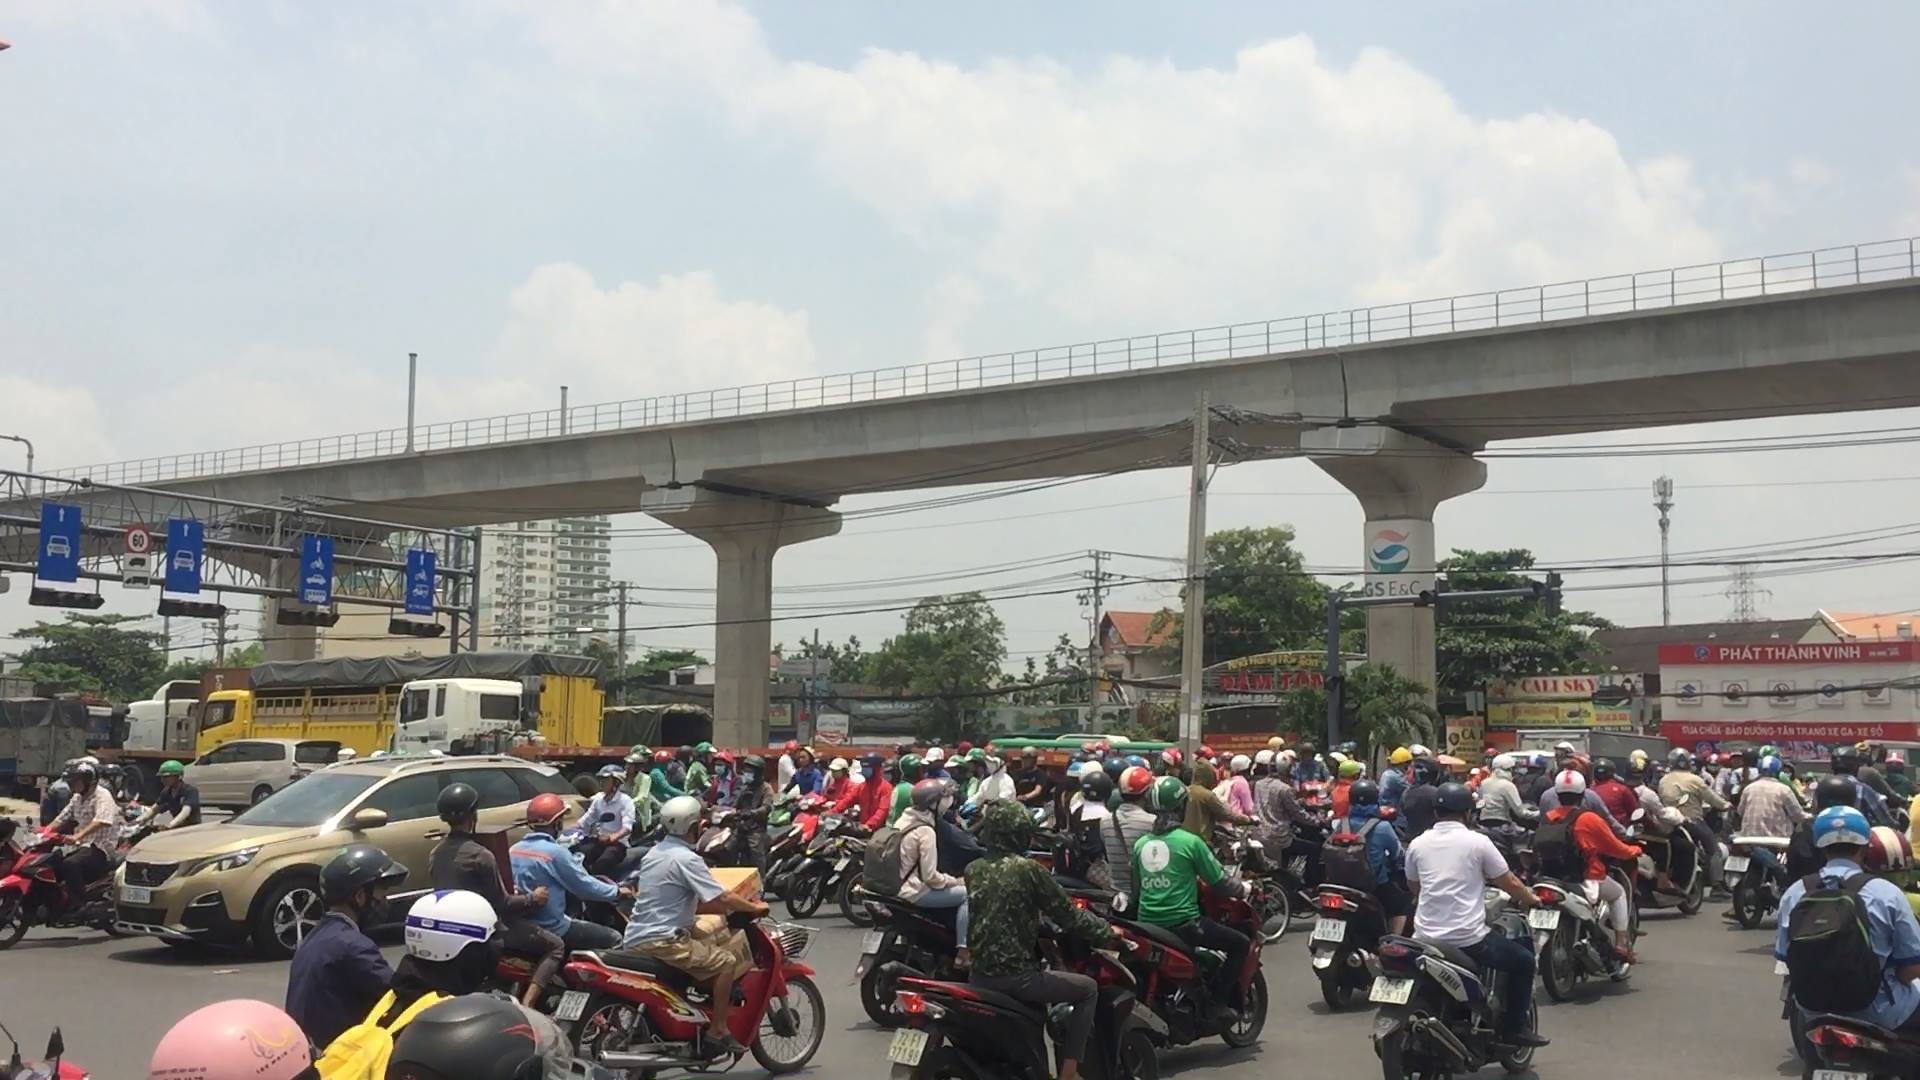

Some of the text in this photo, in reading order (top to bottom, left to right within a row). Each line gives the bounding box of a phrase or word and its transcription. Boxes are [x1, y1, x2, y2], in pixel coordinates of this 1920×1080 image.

[132, 533, 145, 548] 60
[1365, 582, 1385, 598] GS
[1720, 645, 1762, 660] PHÁT
[1765, 644, 1820, 660] THÀNH
[1823, 646, 1860, 659] VINH
[1521, 678, 1597, 694] CALI SKY
[1141, 875, 1171, 890] Grab
